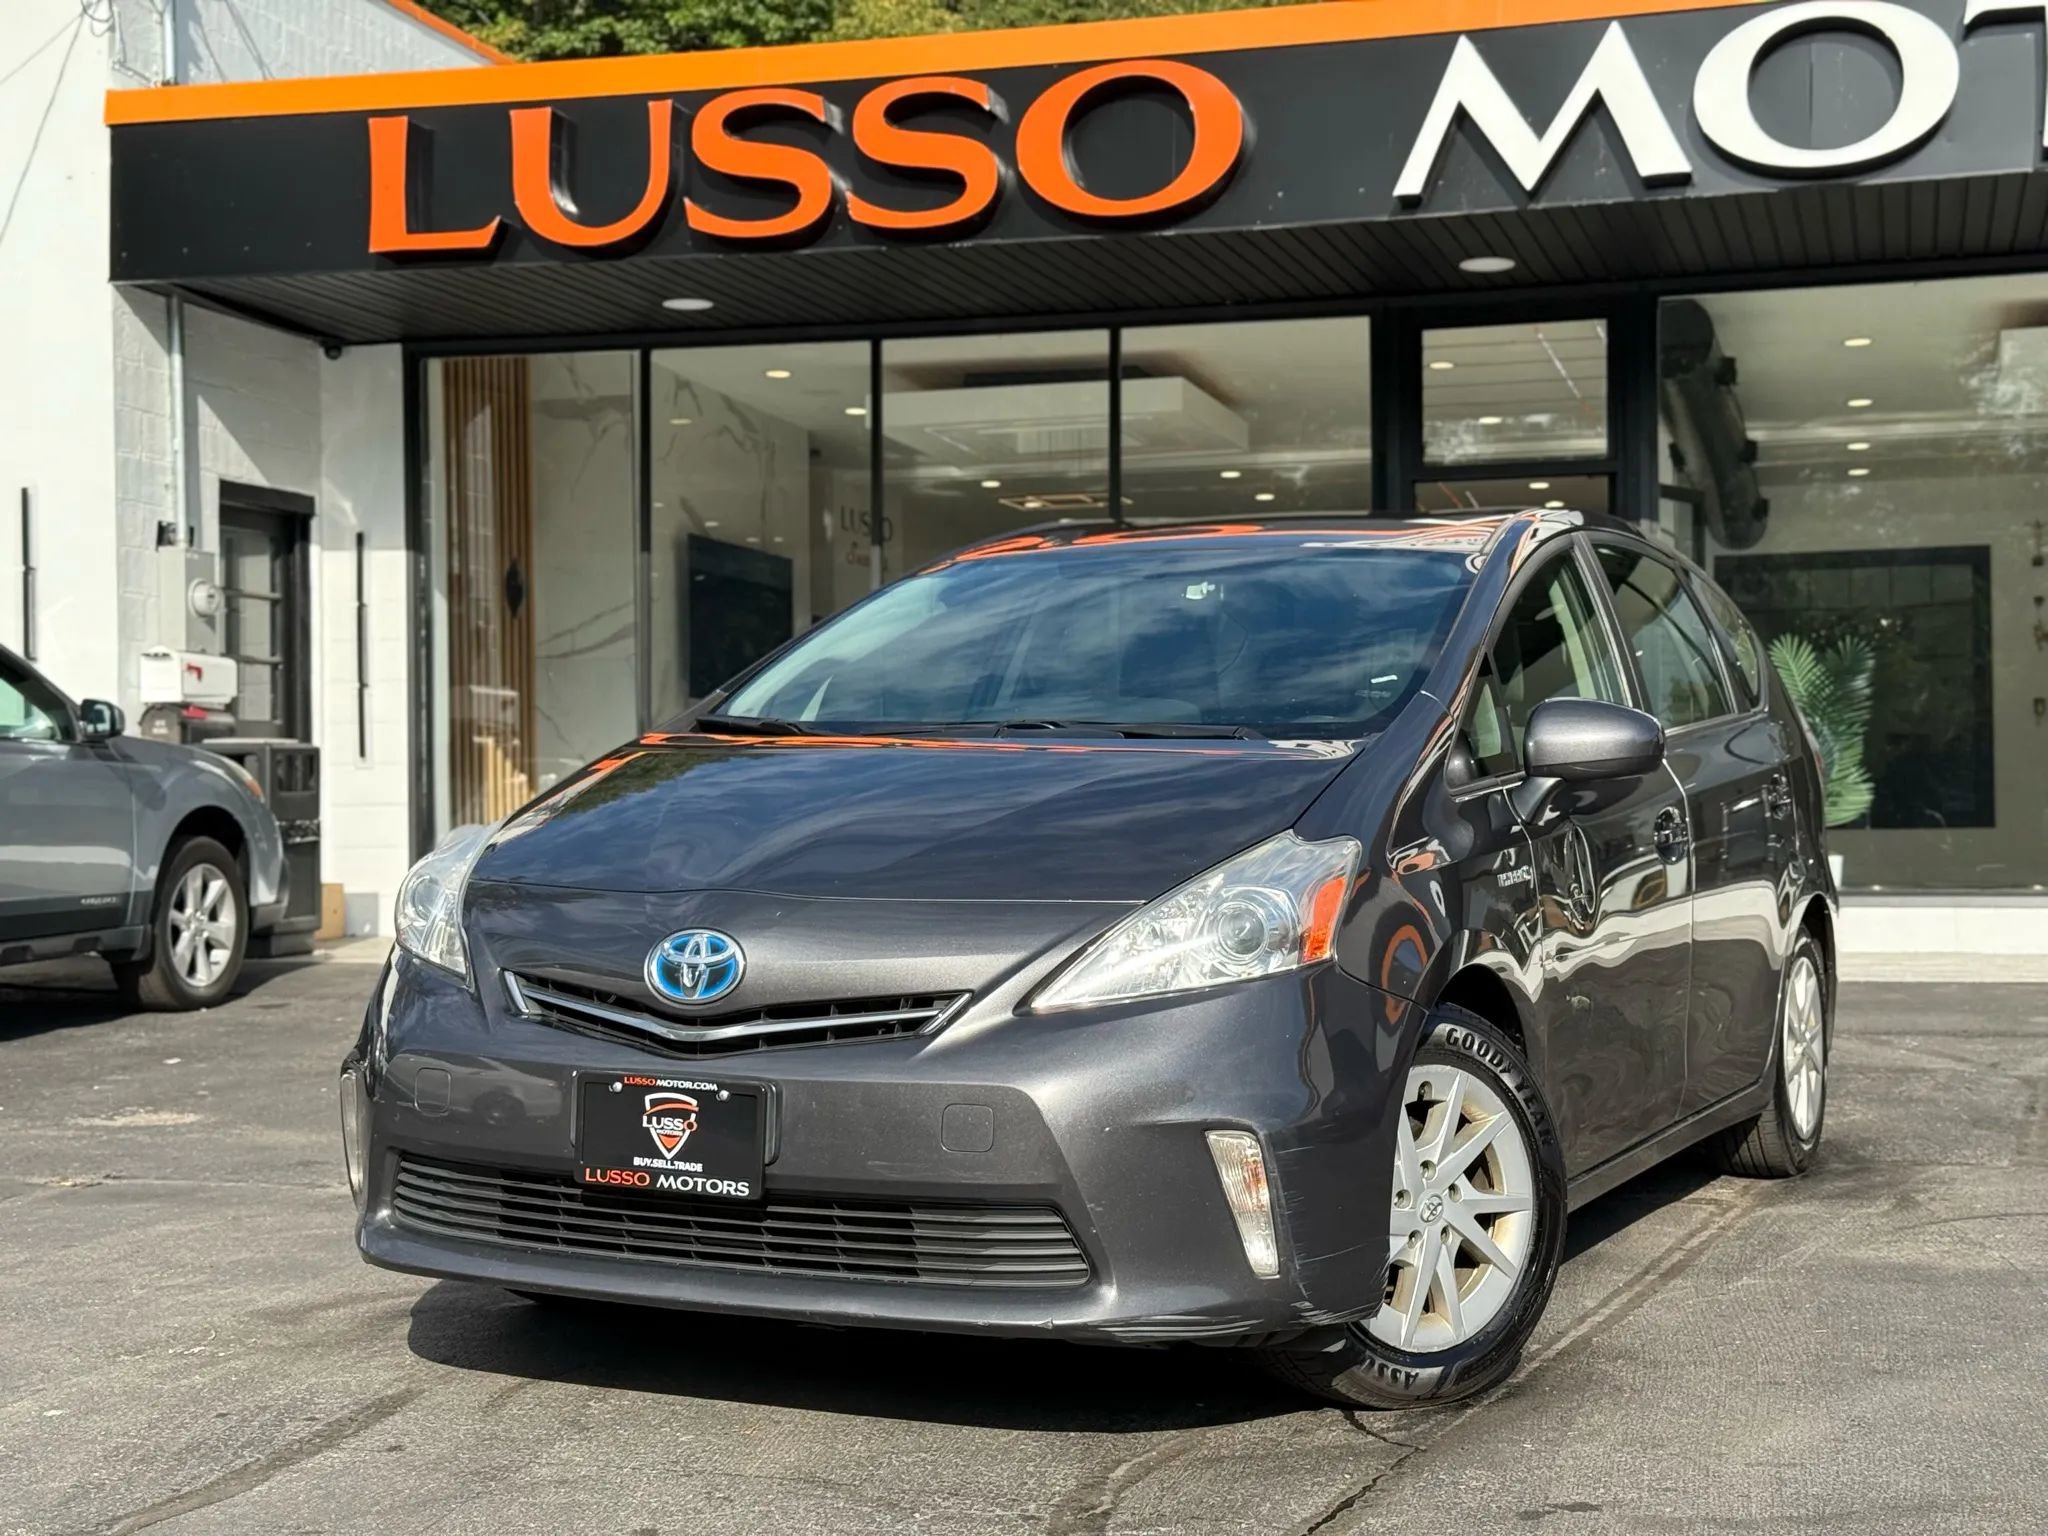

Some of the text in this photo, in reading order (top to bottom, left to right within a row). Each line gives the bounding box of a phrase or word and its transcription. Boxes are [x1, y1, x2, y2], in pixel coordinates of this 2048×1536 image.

[368, 59, 1244, 254] LUSSO
[642, 1115, 698, 1132] LUSSO
[585, 1167, 750, 1197] LUSSO MOTORS
